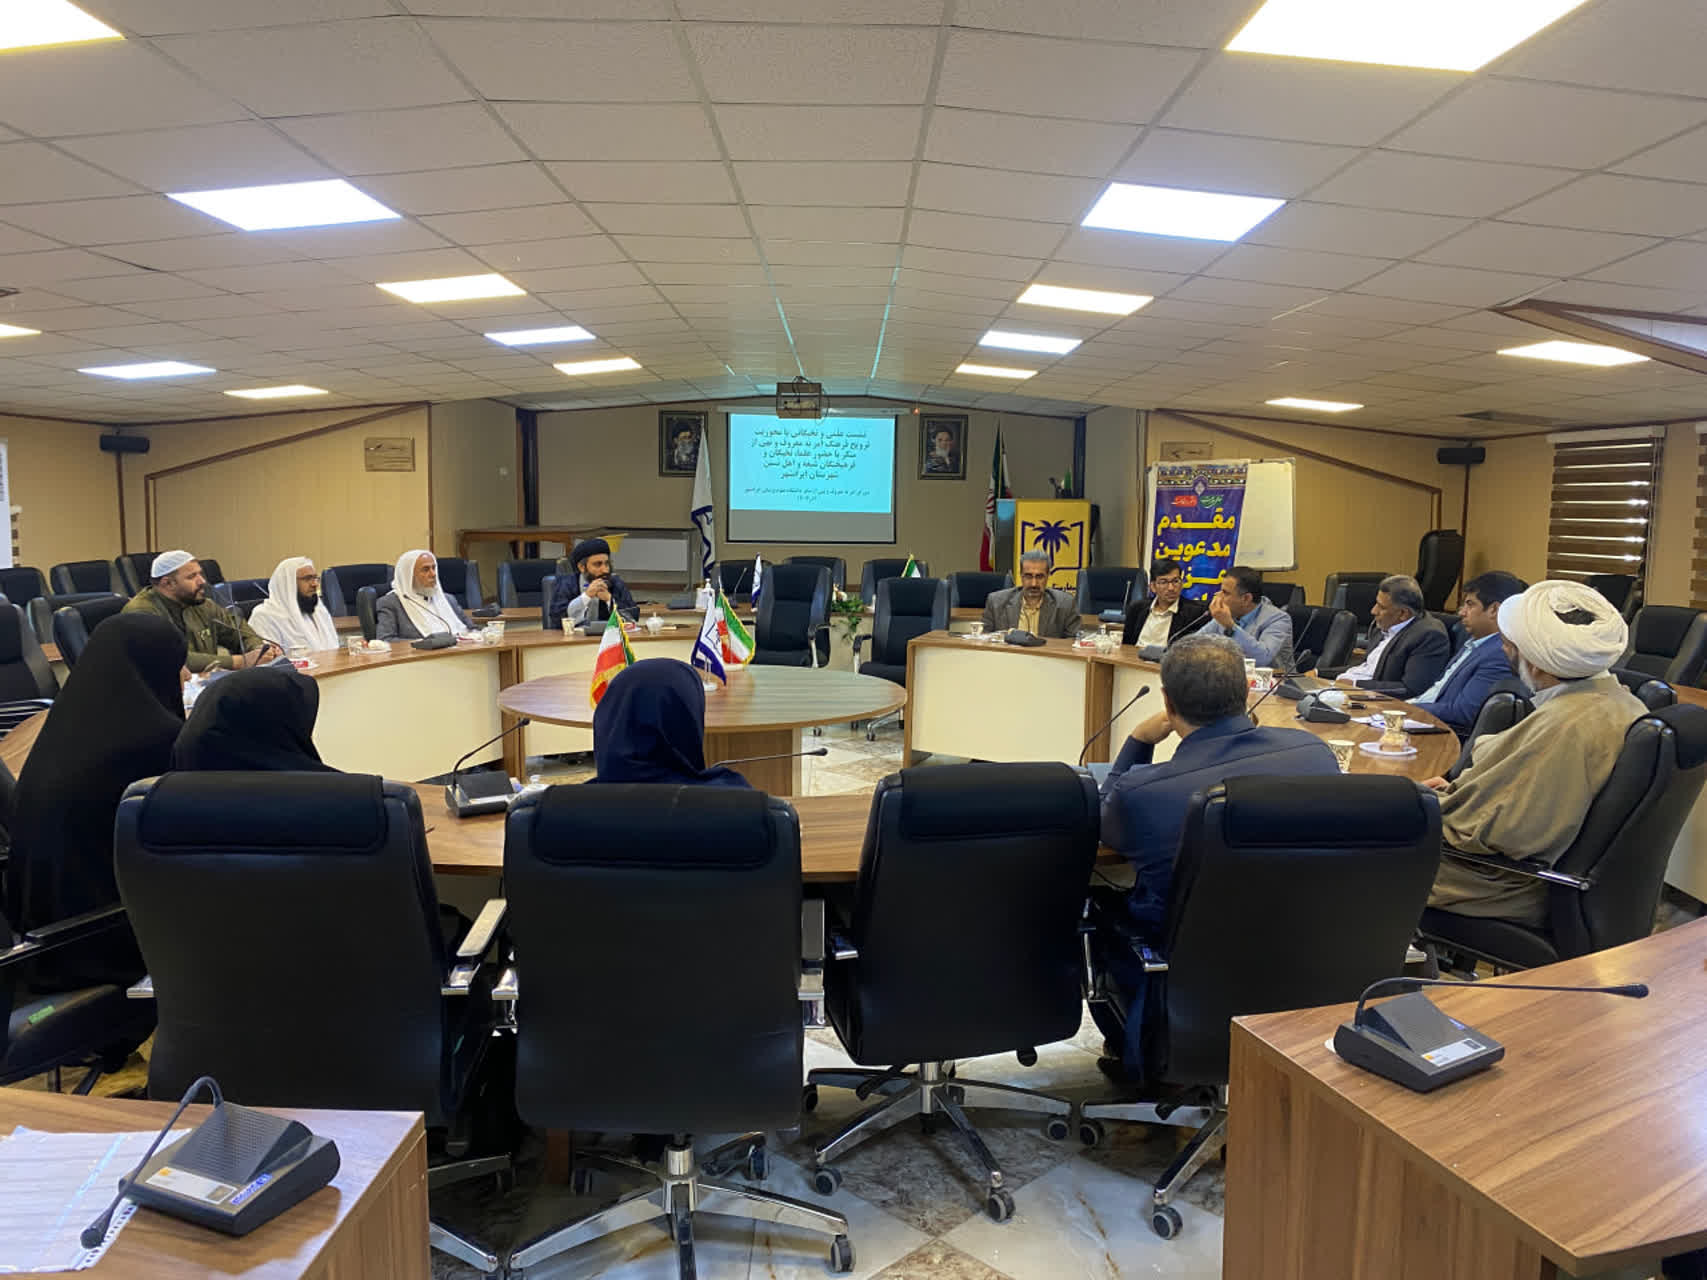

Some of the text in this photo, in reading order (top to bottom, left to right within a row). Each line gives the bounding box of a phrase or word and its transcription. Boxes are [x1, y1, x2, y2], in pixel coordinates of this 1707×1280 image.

[1157, 507, 1236, 536] مقدم
[1155, 541, 1230, 562] مدعوین
[1182, 566, 1227, 588] عز
